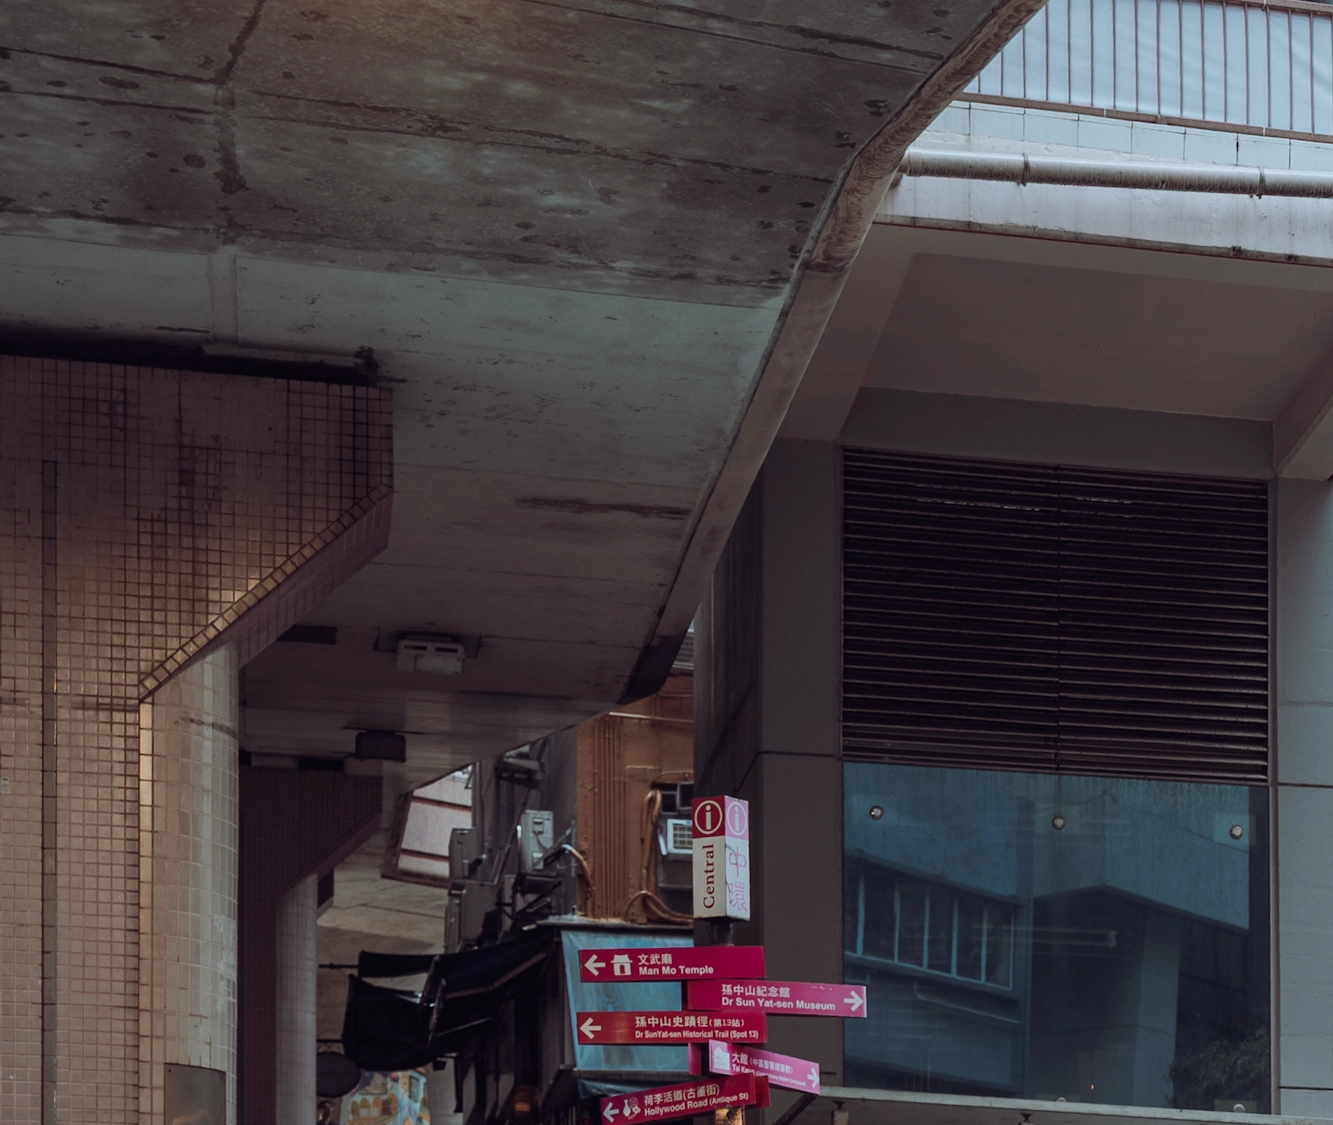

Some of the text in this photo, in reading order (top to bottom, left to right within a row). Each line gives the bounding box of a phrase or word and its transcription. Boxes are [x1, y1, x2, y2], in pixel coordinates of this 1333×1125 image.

[702, 843, 715, 909] Central
[728, 846, 748, 912] 中環
[637, 953, 673, 965] 文武廟
[638, 965, 714, 976] Man Mo Temple
[721, 984, 791, 998] 孫中山紀念館
[721, 997, 836, 1011] Dr Sun Yat-sen Museum
[635, 1030, 643, 1038] Dr
[682, 1030, 713, 1039] Historical
[714, 1030, 728, 1038] Trail
[729, 1030, 747, 1039] (Spot
[748, 1030, 759, 1039] 13)
[643, 1092, 749, 1117] Hollywood Road (Antique St)
